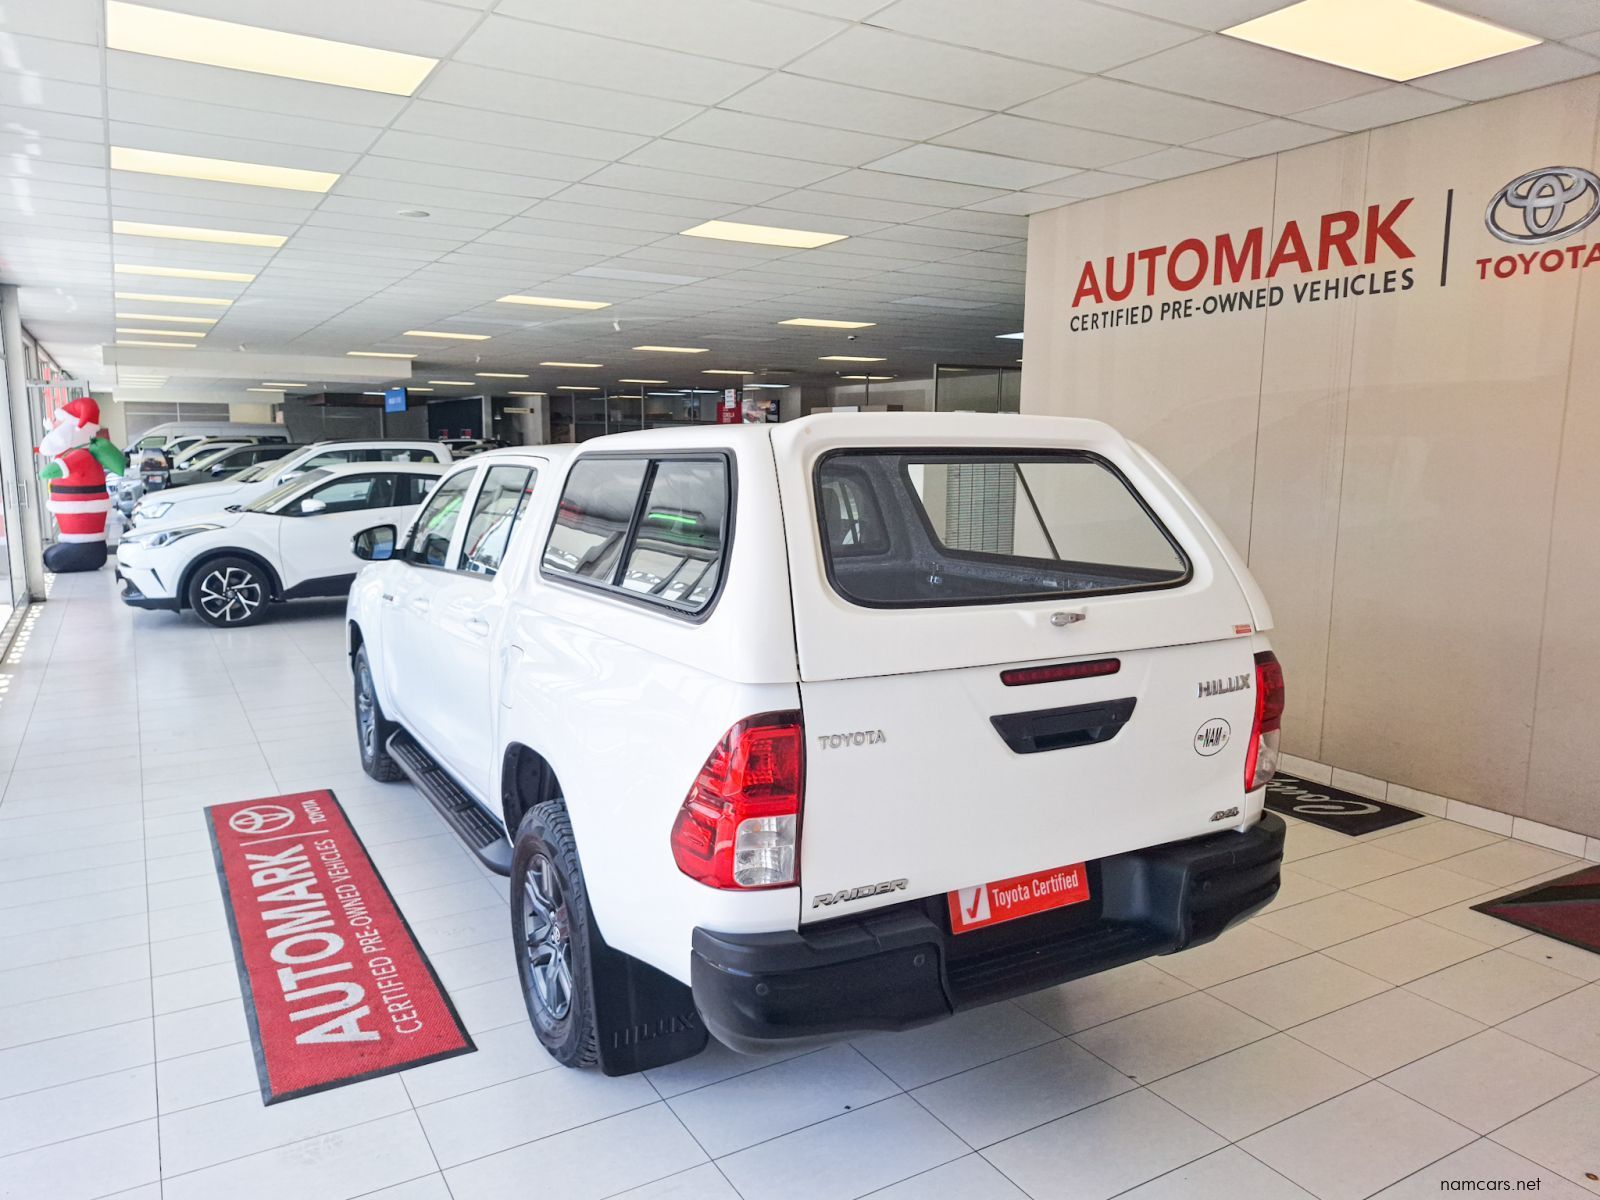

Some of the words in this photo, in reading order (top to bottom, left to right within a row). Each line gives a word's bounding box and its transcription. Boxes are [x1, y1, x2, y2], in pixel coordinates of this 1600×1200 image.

[1072, 198, 1416, 307] AUTOMARK
[1476, 242, 1600, 280] TOYOTA
[1070, 304, 1153, 332] CERTIFIED
[1160, 285, 1284, 321] PRE-OWNED
[1293, 267, 1415, 306] VEHICLES
[1198, 673, 1251, 698] HILUX
[818, 729, 887, 750] TOYOTA
[300, 799, 328, 825] TOYOTA
[314, 838, 352, 884] VEHICLES
[812, 878, 909, 908] RAIDER
[992, 884, 1030, 909] Toyota
[1032, 870, 1079, 897] Certified
[342, 884, 391, 955] PRE-OWNED
[244, 843, 381, 1045] AUTOMARK
[368, 954, 423, 1034] CERTIFIED
